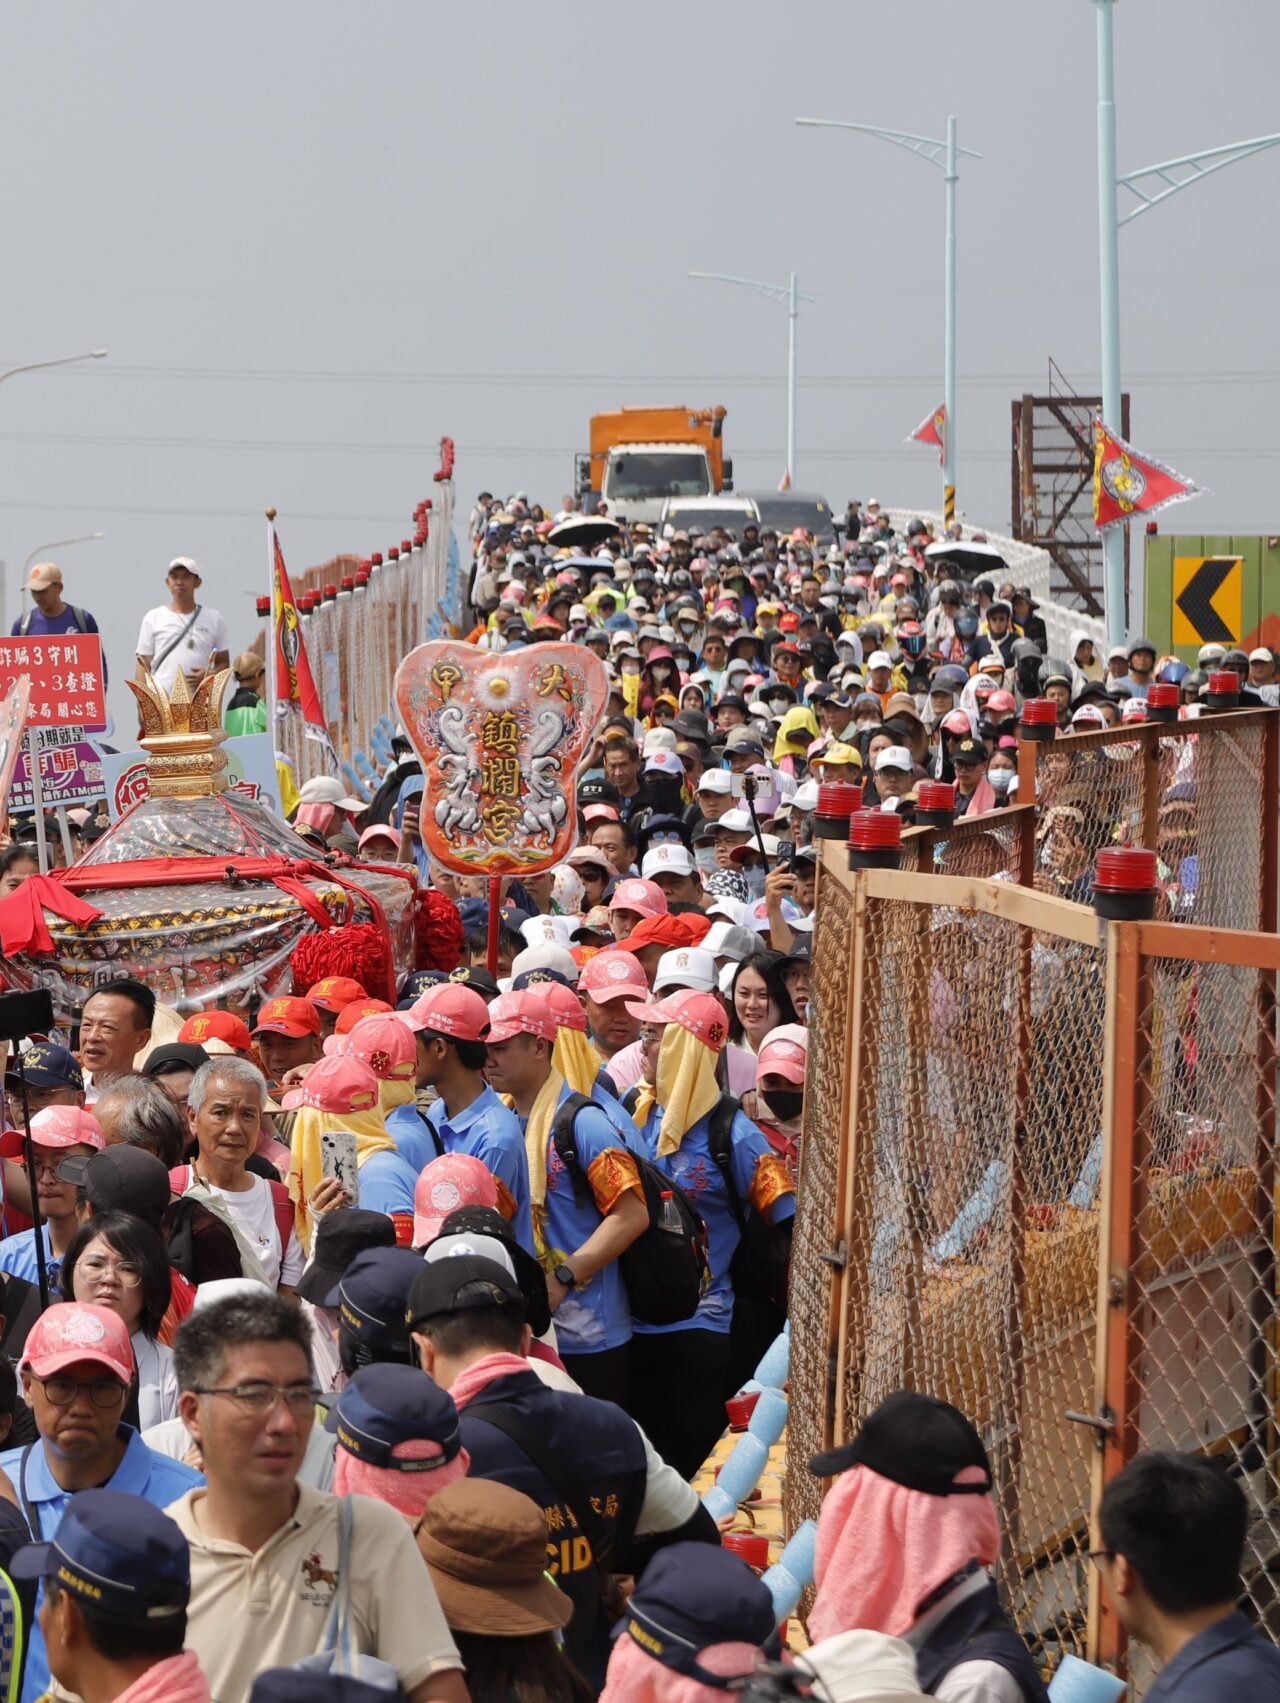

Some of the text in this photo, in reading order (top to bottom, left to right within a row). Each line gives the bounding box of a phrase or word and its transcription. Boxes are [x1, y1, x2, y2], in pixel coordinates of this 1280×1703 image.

[481, 710, 521, 847] 鎮瀾宮
[583, 785, 602, 793] GTI
